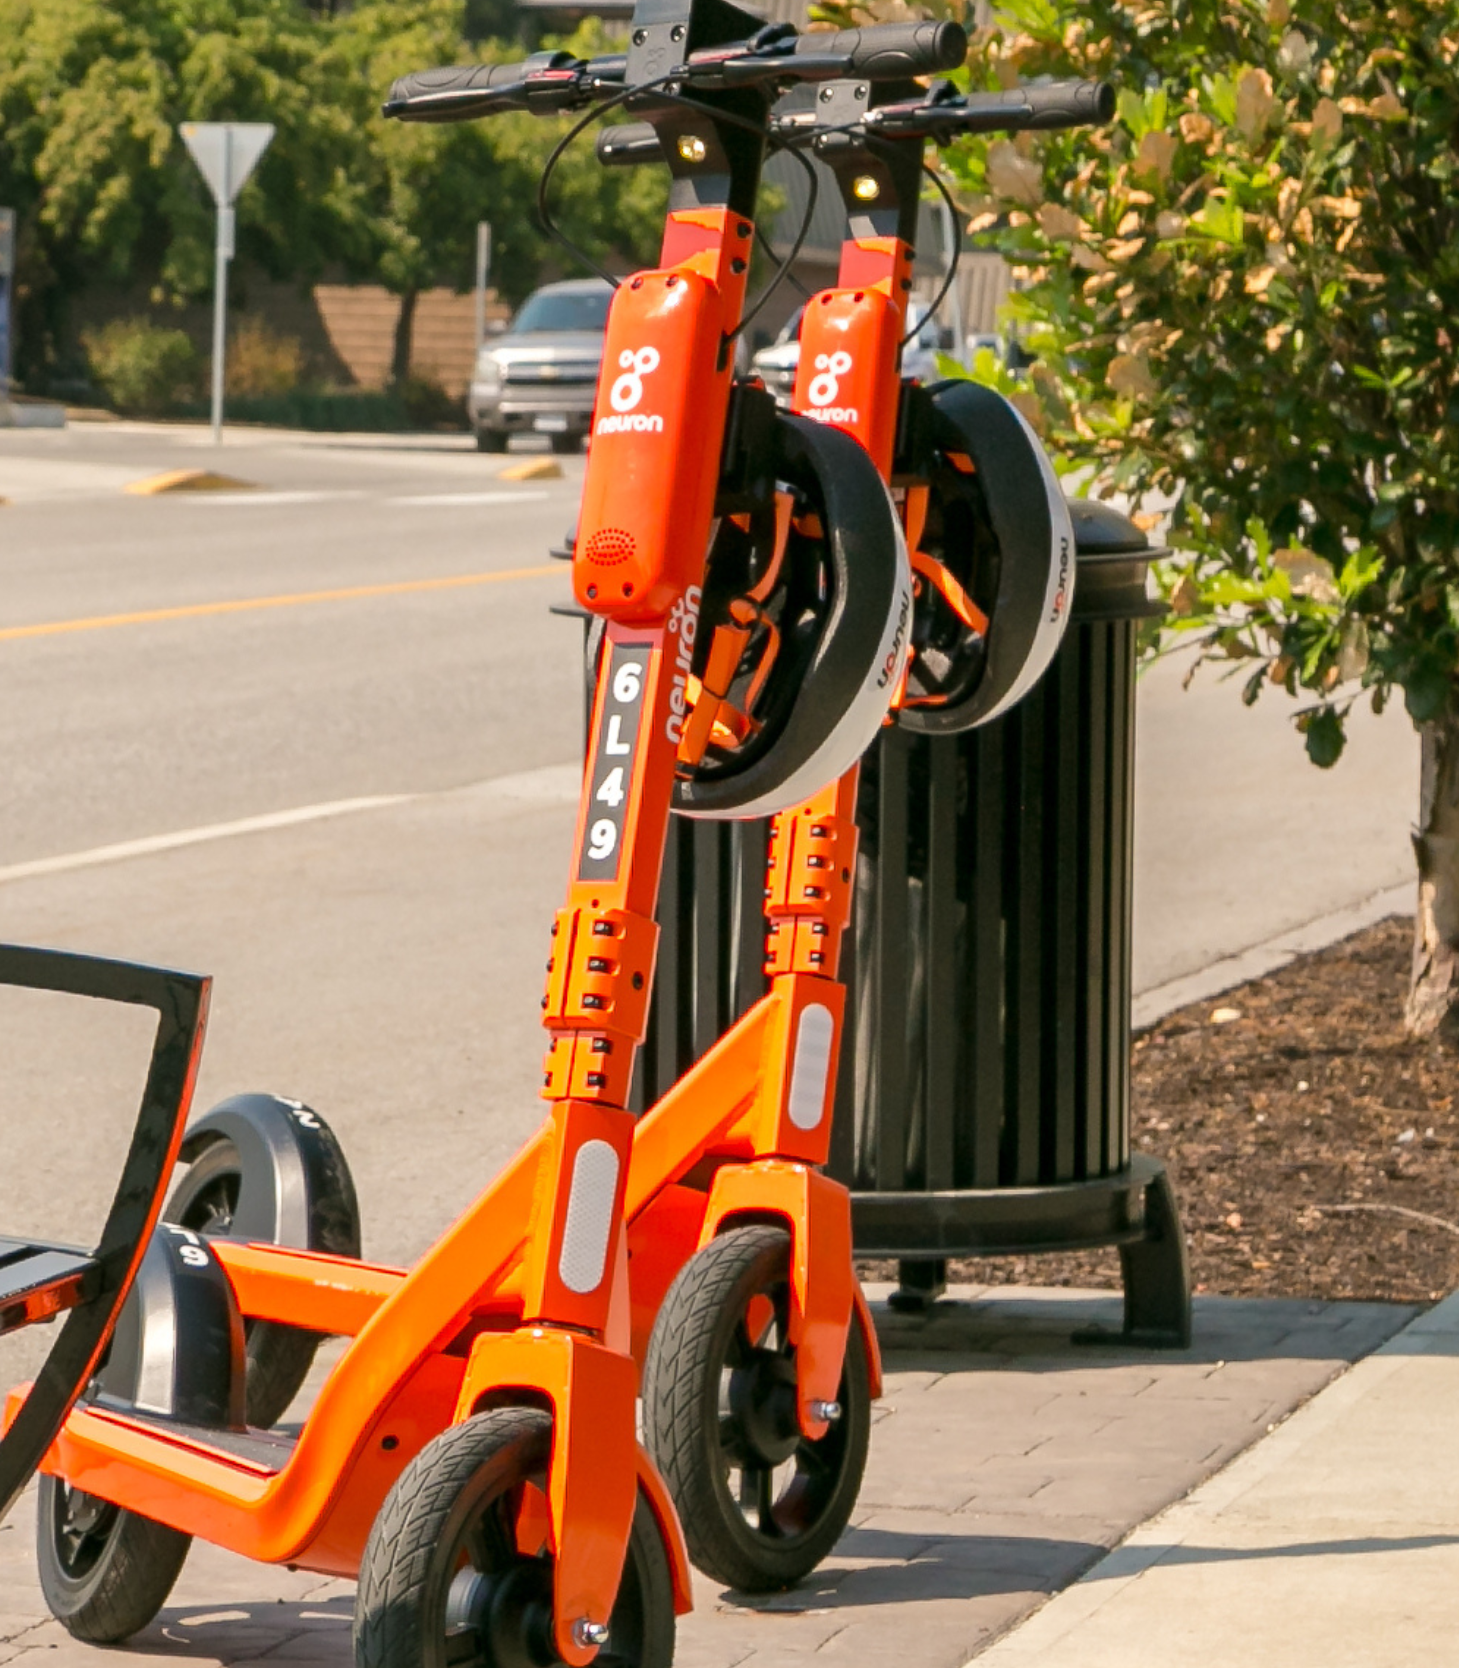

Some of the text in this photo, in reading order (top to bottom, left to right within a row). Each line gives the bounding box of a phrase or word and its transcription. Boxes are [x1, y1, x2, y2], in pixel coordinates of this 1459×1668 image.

[596, 413, 664, 436] neuron
[1049, 536, 1069, 623] neuron
[666, 585, 702, 744] neuron
[877, 590, 910, 689] neuron
[587, 661, 643, 861] 6L49
